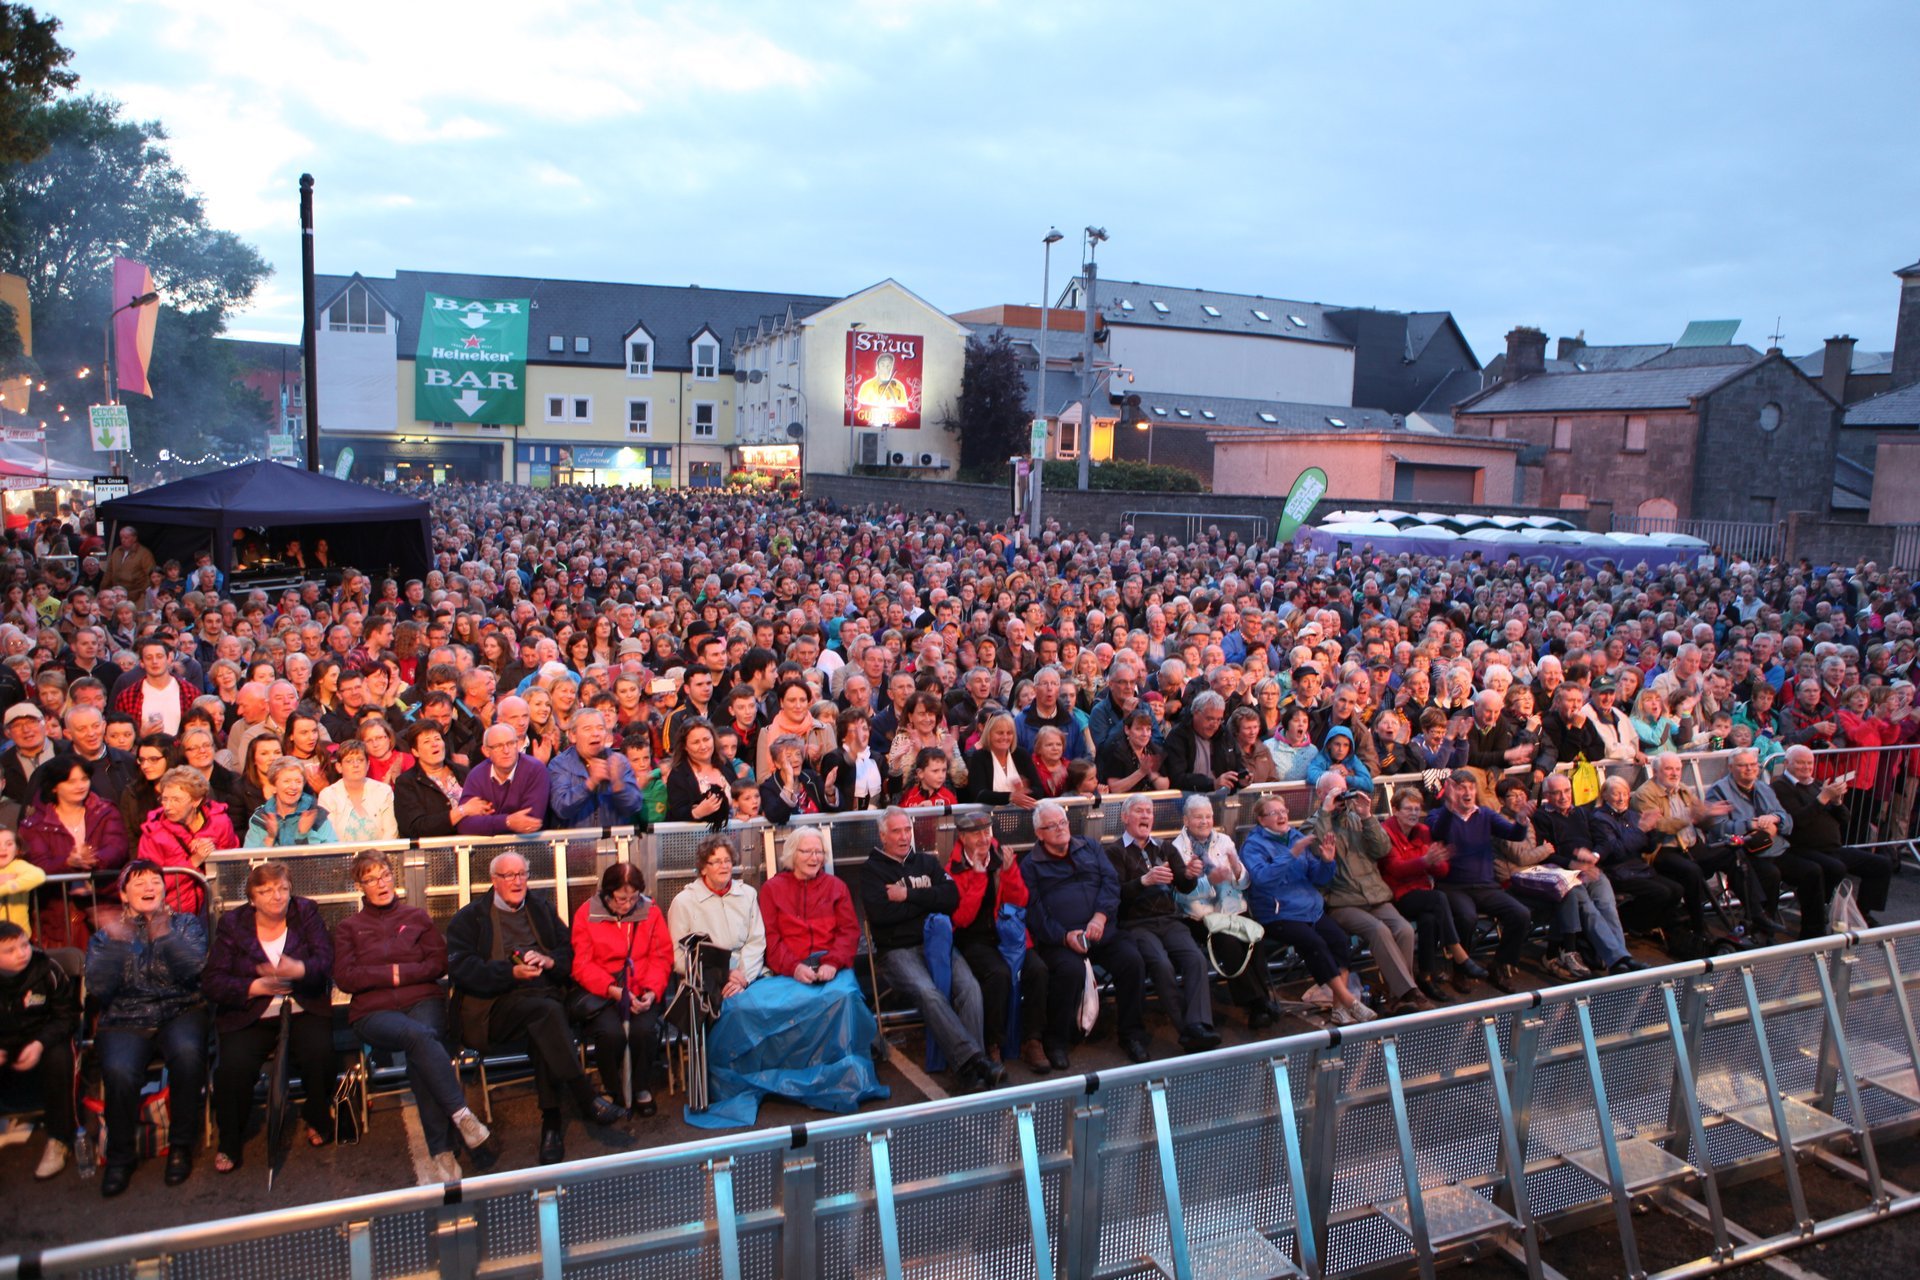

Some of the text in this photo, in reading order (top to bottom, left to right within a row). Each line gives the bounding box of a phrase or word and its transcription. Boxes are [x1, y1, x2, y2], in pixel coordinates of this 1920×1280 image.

[432, 297, 521, 314] BAR
[432, 347, 510, 362] Heineken
[855, 333, 915, 360] Snug
[424, 367, 518, 390] BAR
[93, 417, 128, 427] STATION
[1293, 481, 1325, 522] STATION
